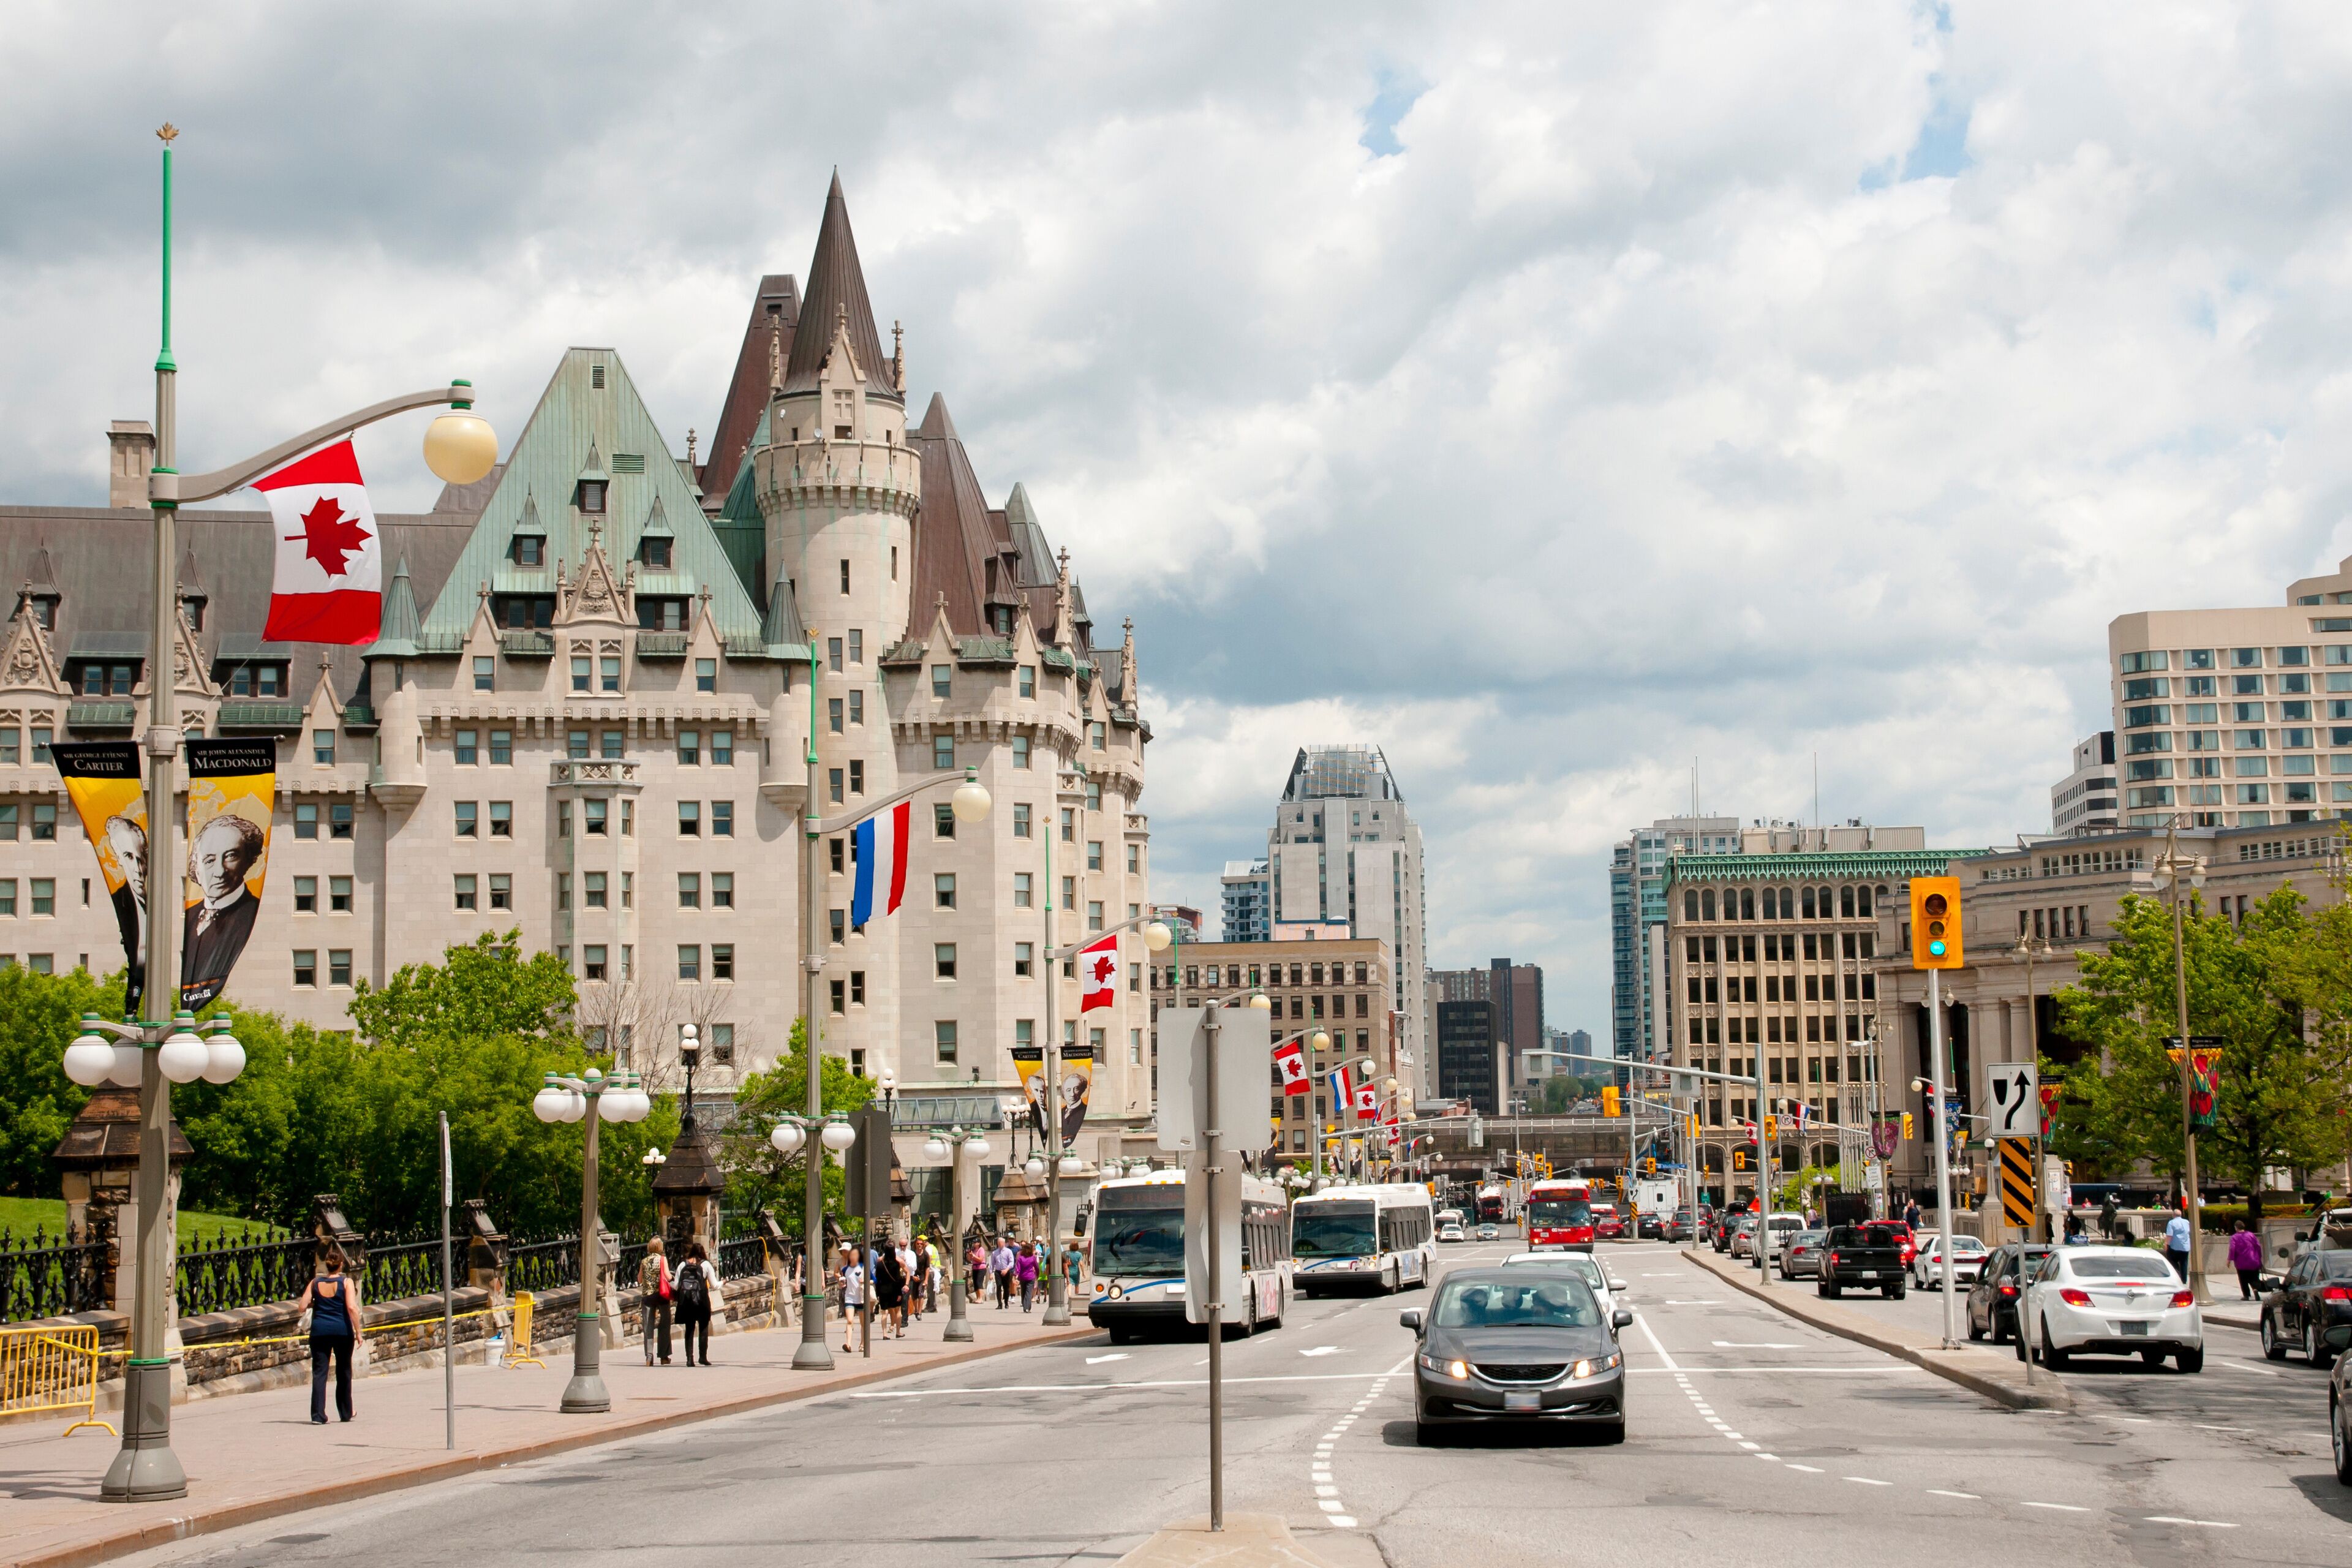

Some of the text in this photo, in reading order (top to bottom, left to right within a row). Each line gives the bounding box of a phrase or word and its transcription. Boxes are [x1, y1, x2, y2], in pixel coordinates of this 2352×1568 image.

[74, 759, 124, 771] CARTIER
[194, 757, 272, 769] MACDONALD
[183, 989, 211, 1001] Canada
